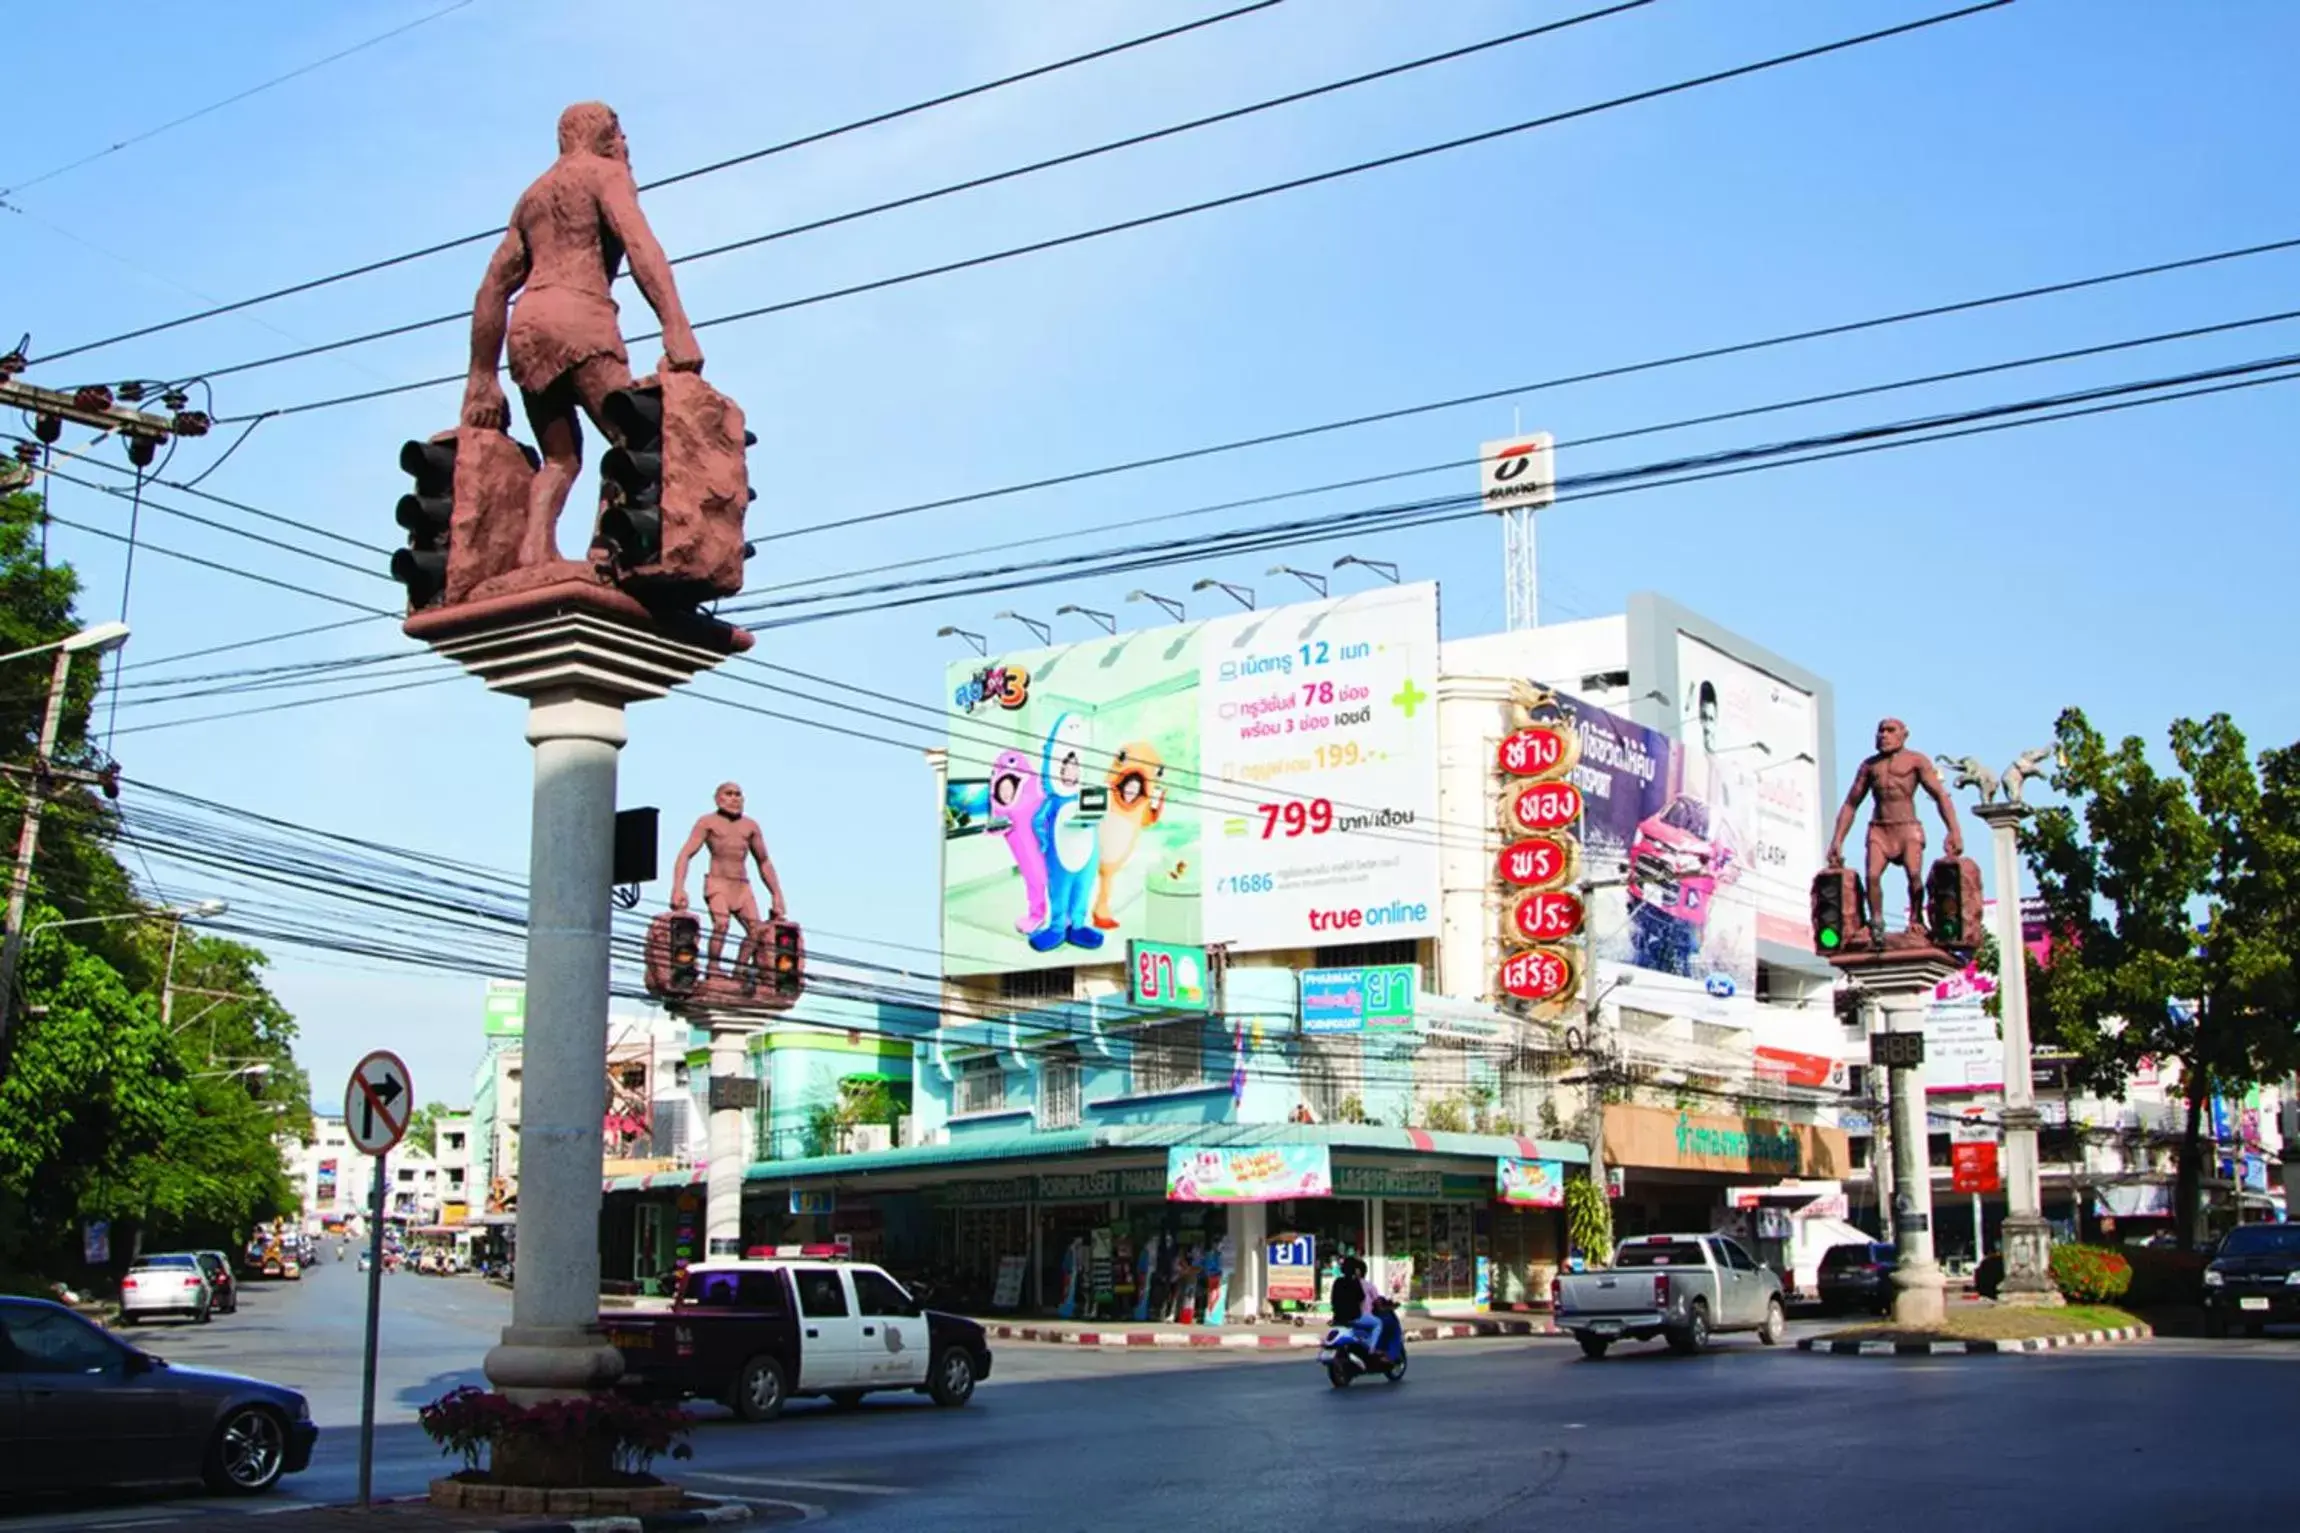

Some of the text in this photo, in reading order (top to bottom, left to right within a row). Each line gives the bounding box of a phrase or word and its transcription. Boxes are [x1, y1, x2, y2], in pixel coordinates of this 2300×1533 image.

[1299, 640, 1330, 667] 12
[1302, 681, 1334, 707] 78
[1338, 684, 1370, 703] ช่อง
[1284, 718, 1294, 734] 3
[1299, 713, 1330, 732] ช่อง
[1506, 731, 1558, 770] ห้าง
[1258, 798, 1333, 840] 799
[1520, 790, 1576, 822] ทอง
[1511, 849, 1550, 878] พร
[1230, 873, 1273, 893] 1686
[1308, 900, 1427, 931] true online
[1524, 896, 1573, 932] ประ
[1139, 951, 1175, 1000] ยา
[1504, 954, 1559, 992] เสริฐ
[1367, 971, 1412, 1010] ยา
[1276, 1237, 1308, 1265] ยา
